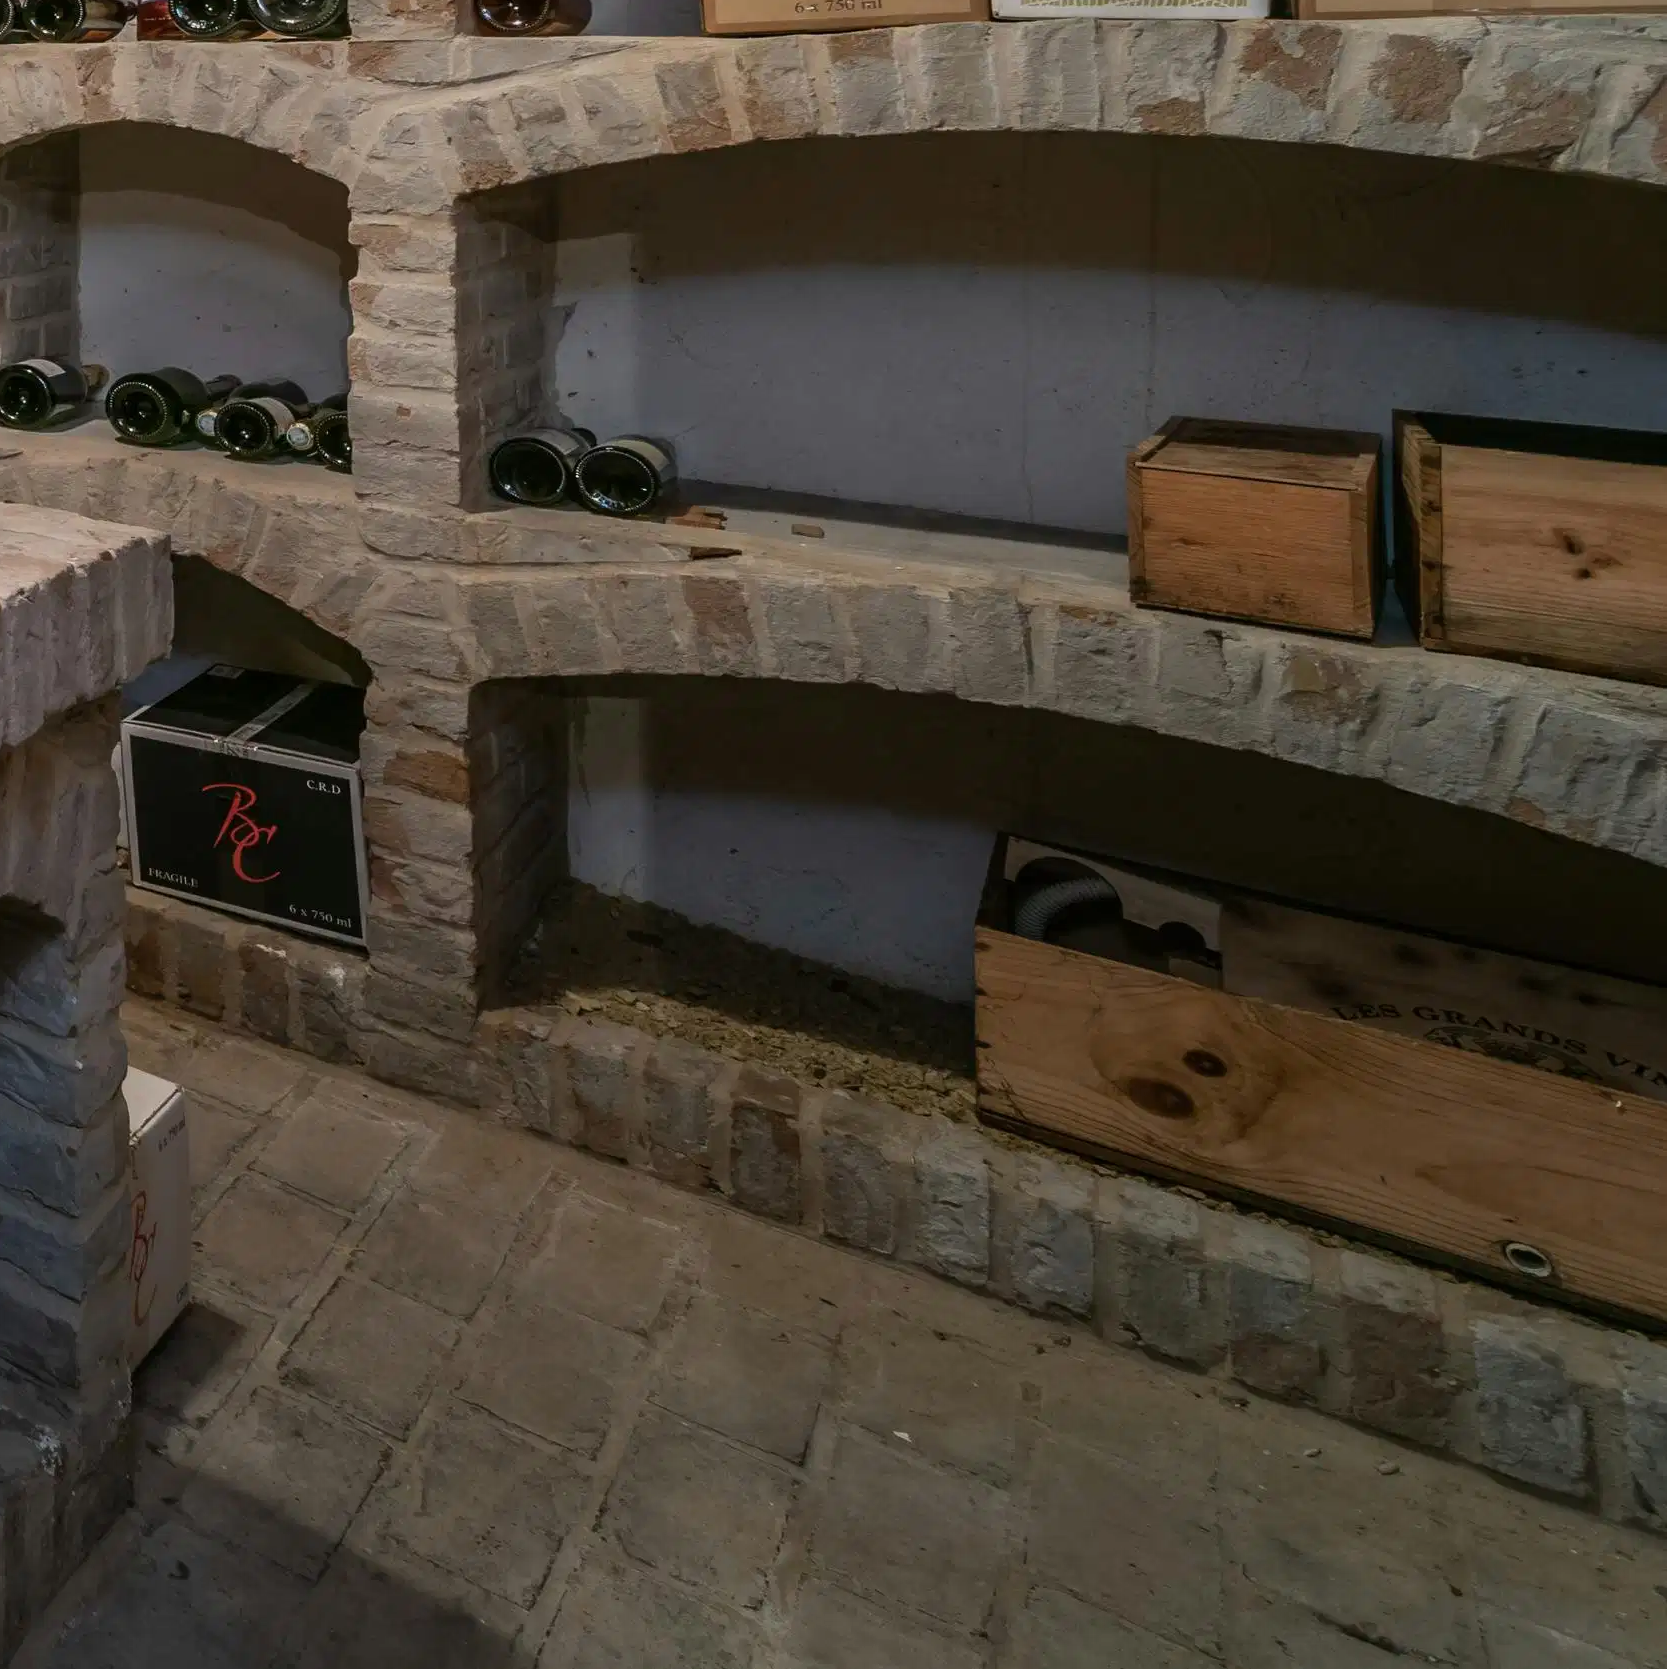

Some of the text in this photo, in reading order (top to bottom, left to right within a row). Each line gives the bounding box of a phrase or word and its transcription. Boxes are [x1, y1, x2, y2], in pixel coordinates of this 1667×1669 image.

[794, 0, 805, 13] 6
[305, 778, 341, 796] C.R.D
[148, 866, 199, 889] FRAGILE
[289, 903, 297, 915] 6
[312, 907, 334, 924] 750
[336, 915, 352, 929] ml
[1329, 1002, 1402, 1021] LES
[1411, 1005, 1589, 1055] GRANDS
